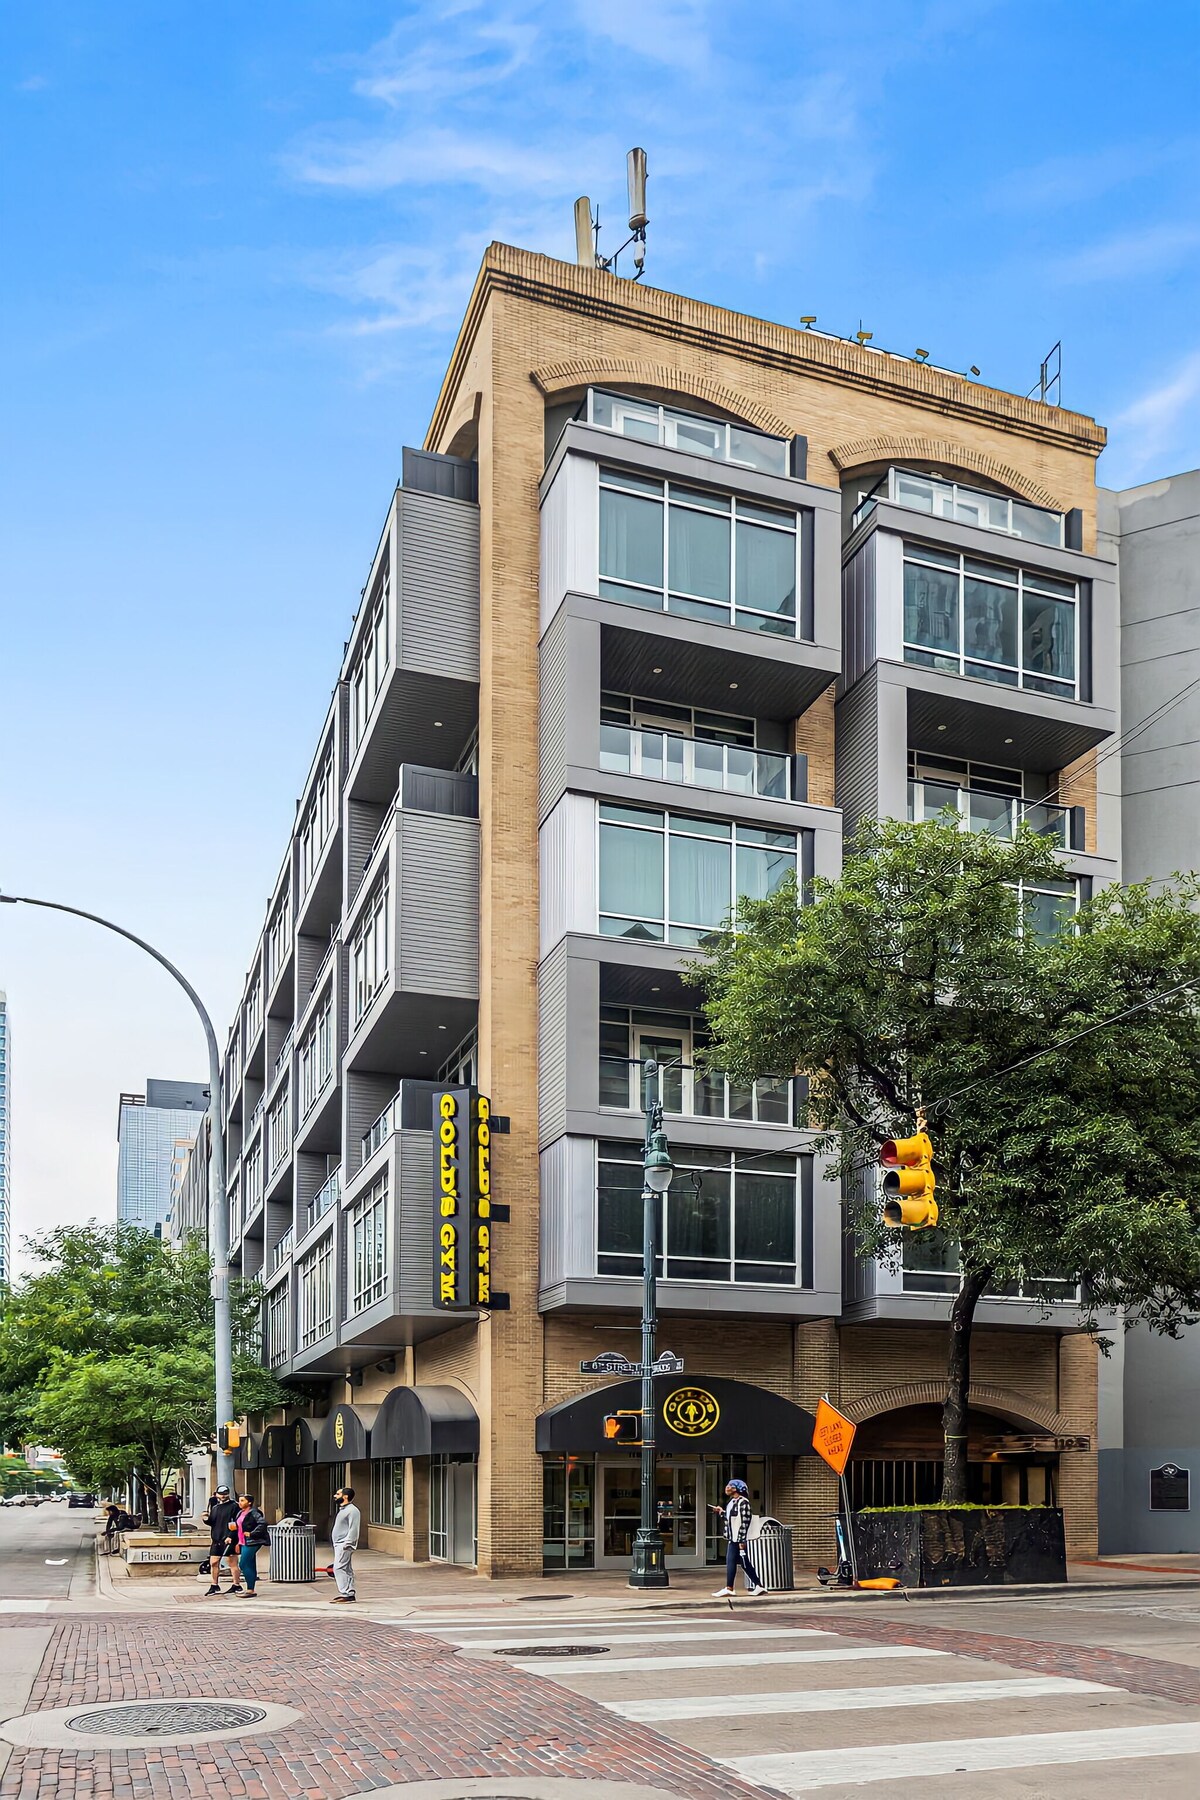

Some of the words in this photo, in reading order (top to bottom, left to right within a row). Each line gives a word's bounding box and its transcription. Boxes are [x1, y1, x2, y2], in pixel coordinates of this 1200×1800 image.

[440, 1093, 457, 1217] GOLD'S
[440, 1223, 456, 1302] GYM
[478, 1225, 490, 1303] GYM
